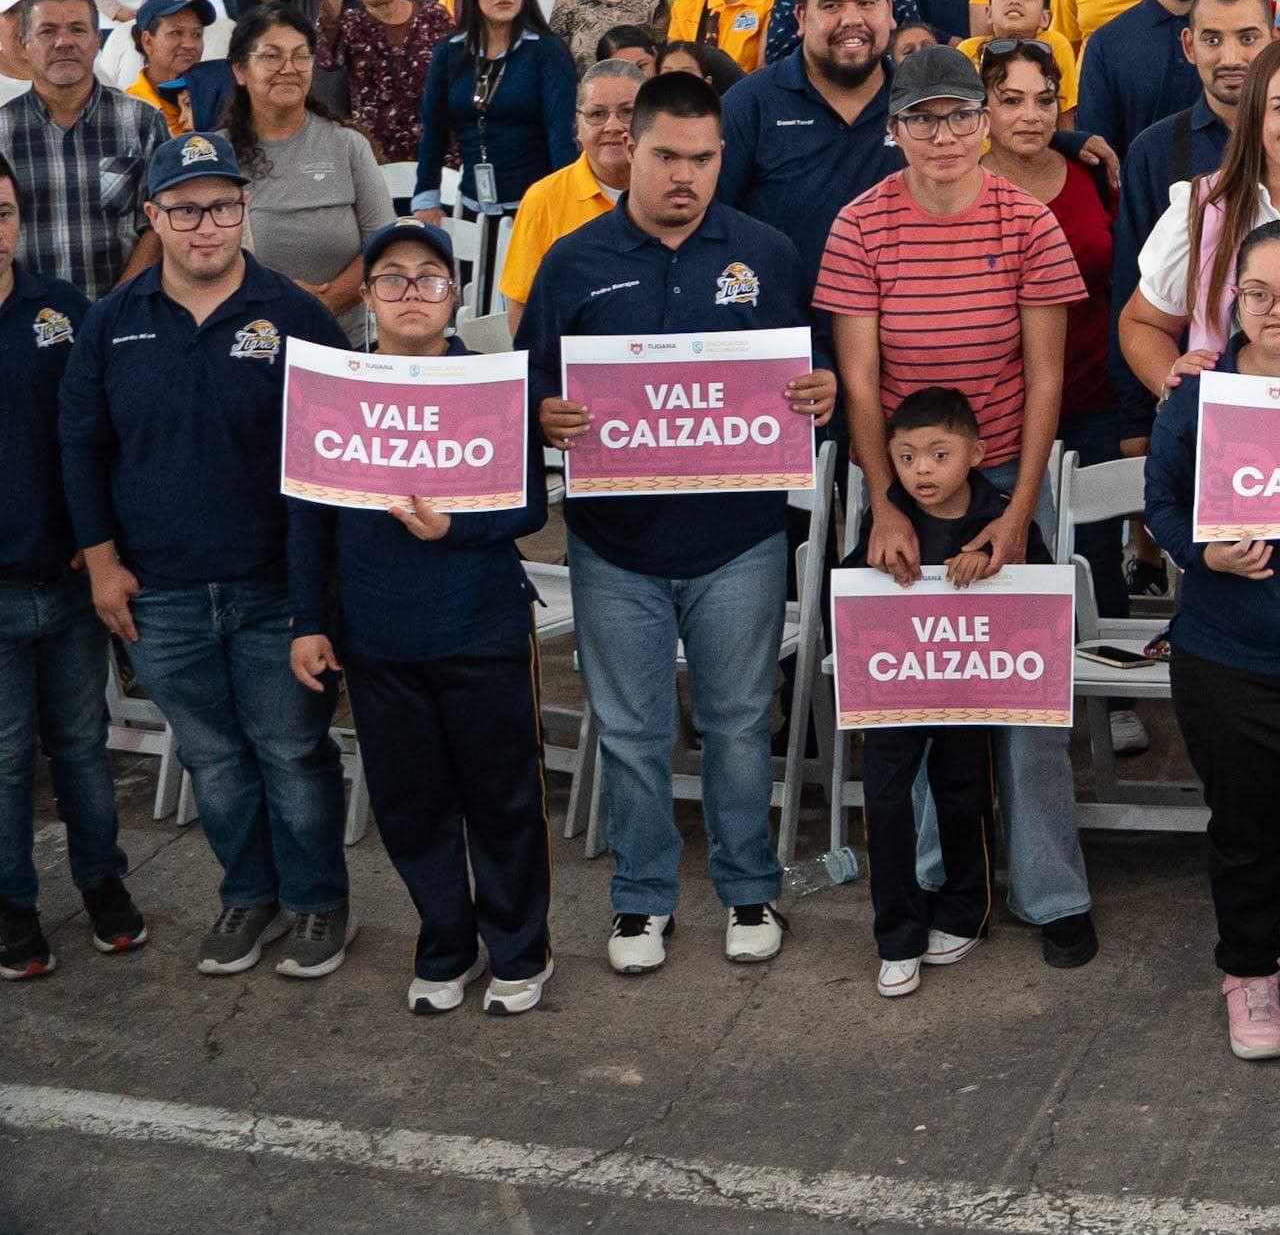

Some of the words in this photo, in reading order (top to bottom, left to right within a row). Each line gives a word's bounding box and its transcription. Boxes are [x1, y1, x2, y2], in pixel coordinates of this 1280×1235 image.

[644, 382, 724, 410] VALE
[360, 402, 440, 432] VALE
[600, 415, 781, 449] CALZADO
[314, 429, 494, 468] CALZADO
[911, 616, 990, 643] VALE
[868, 651, 1044, 681] CALZADO
